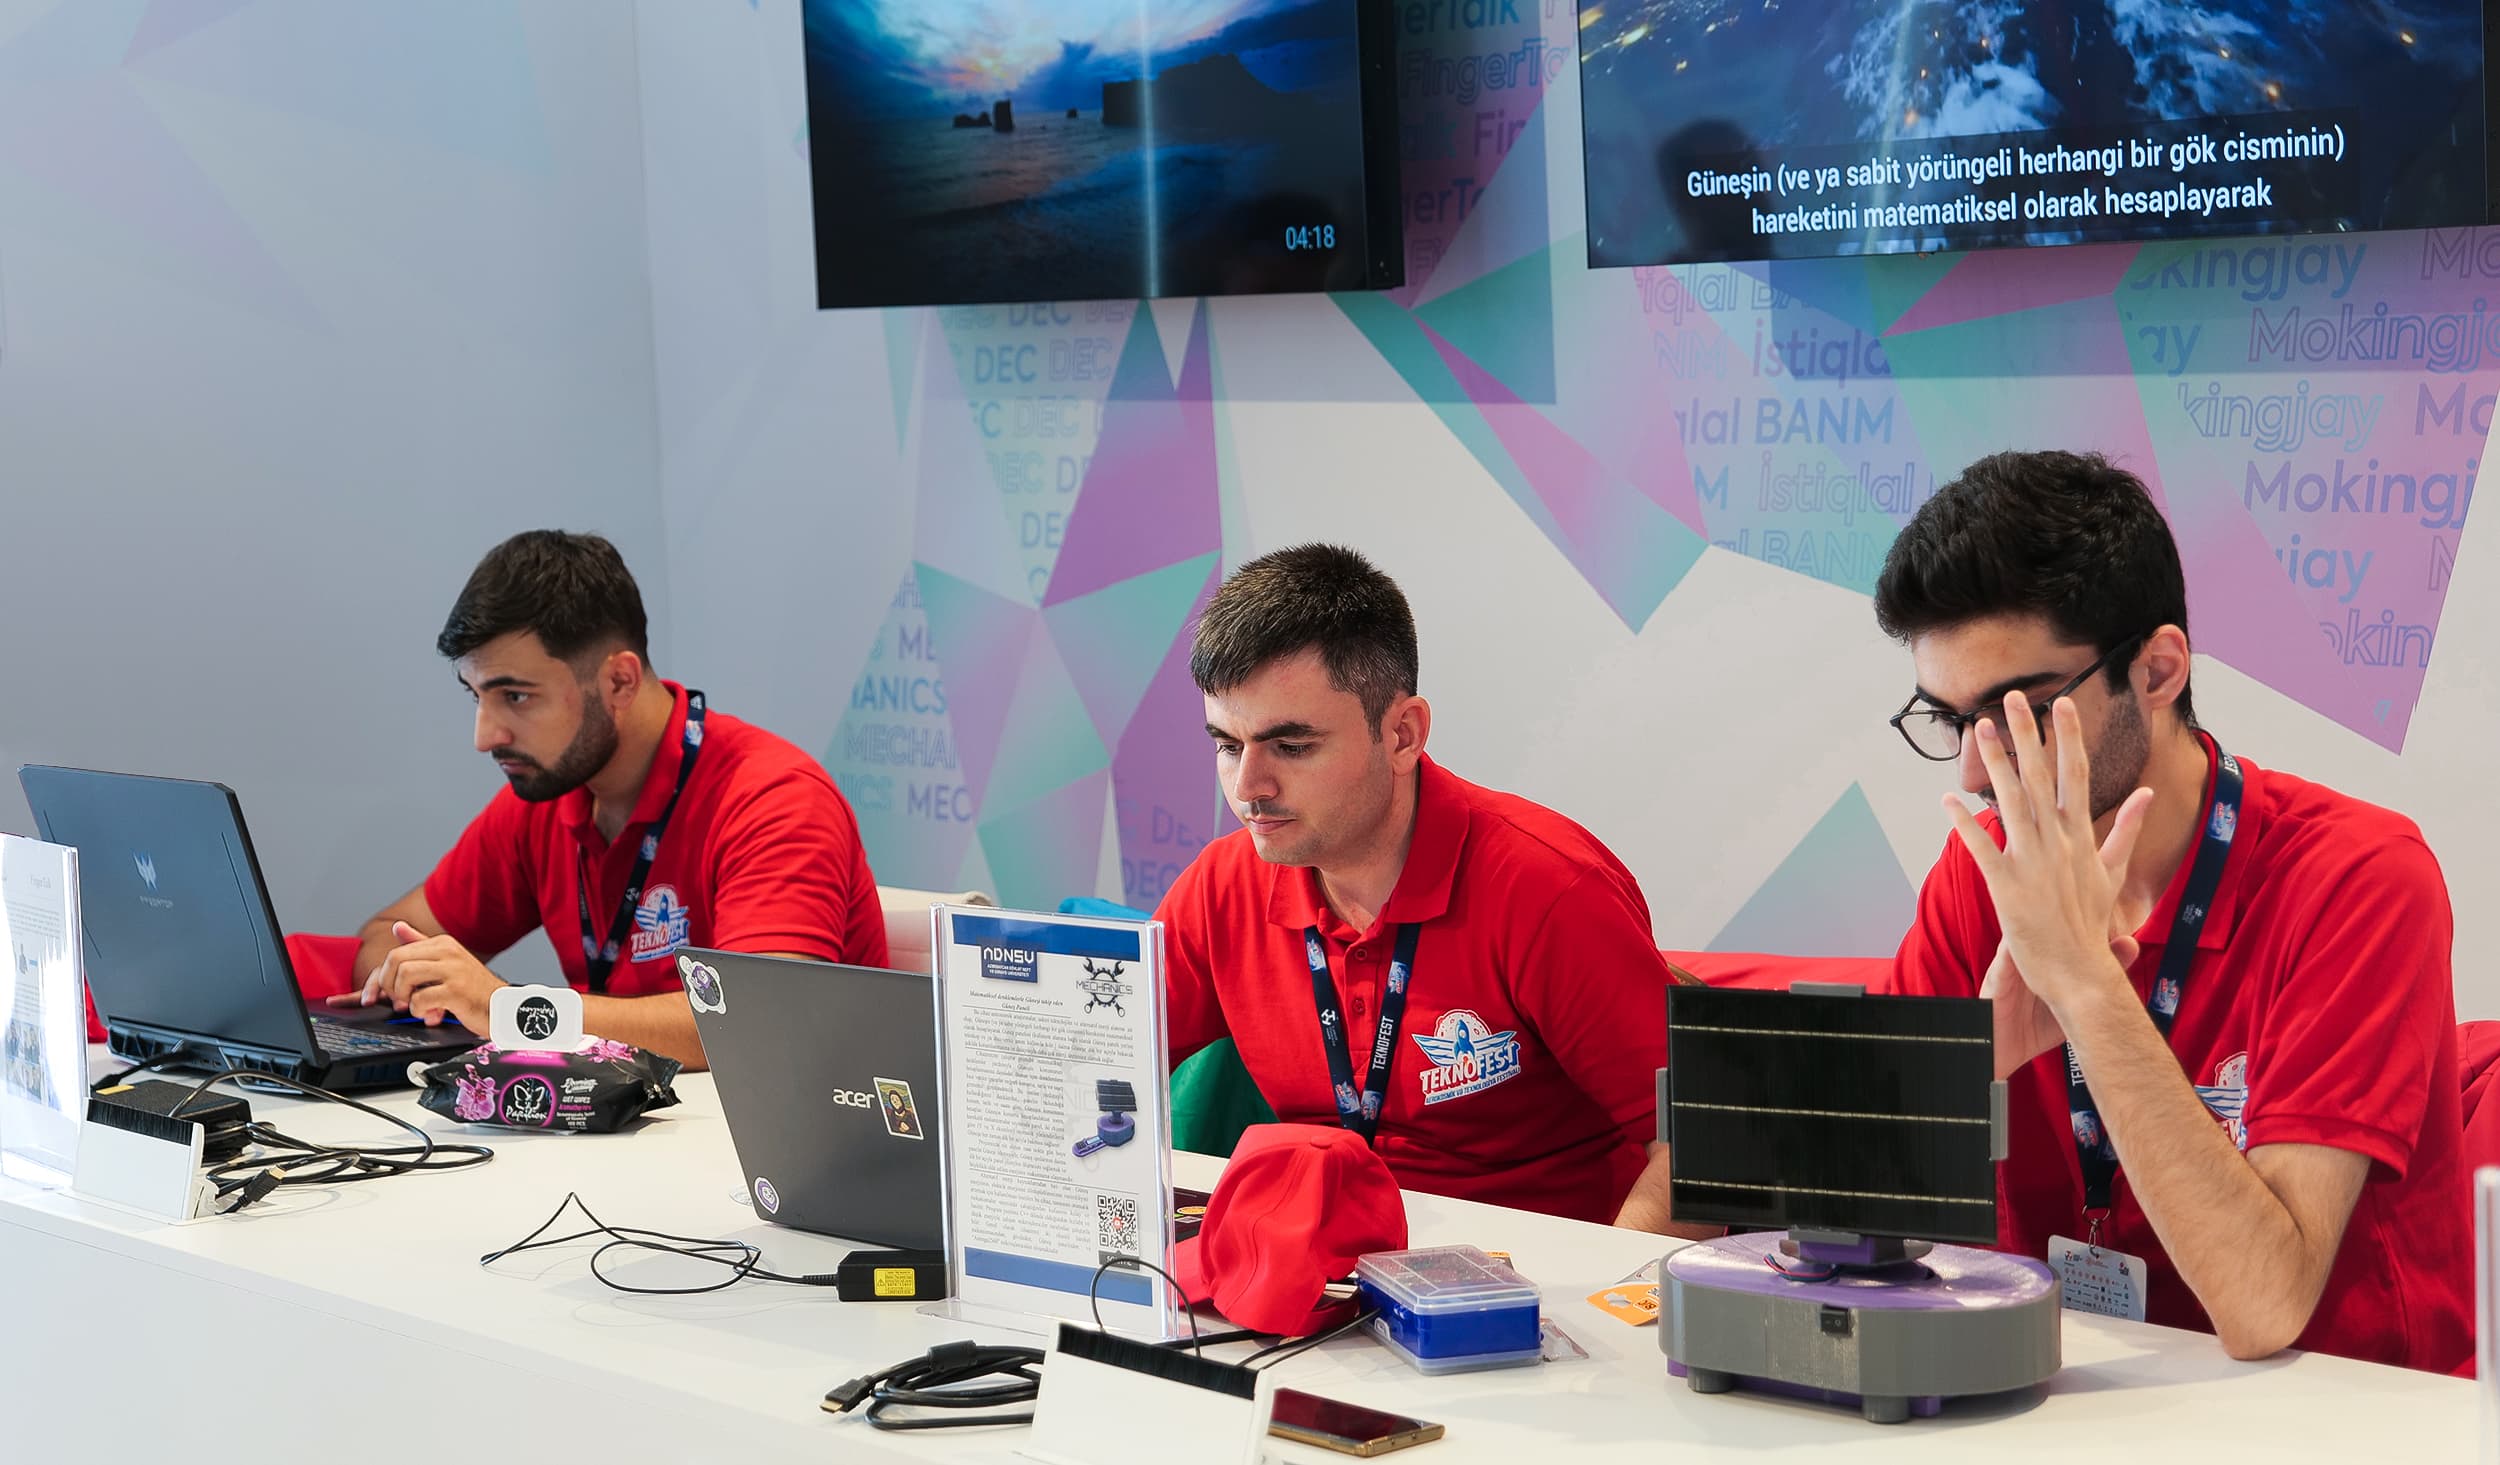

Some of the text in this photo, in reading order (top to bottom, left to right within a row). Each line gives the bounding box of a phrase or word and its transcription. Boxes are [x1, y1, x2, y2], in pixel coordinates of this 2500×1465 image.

[1687, 124, 2345, 200] Güneşin (ve ya sabit yörüngeli herhangi bir gök cisminin)
[1752, 177, 2273, 235] hareketini matematiksel olarak hesaplayarak
[1285, 224, 1336, 250] 04:18
[974, 344, 1038, 385] DEC
[1754, 397, 1895, 445] BANM
[1758, 449, 1915, 528] İstiqlal
[1075, 980, 1134, 996] MECHANICS
[1371, 1015, 1395, 1071] TEKNOFEST
[1420, 1041, 1521, 1094] TEKNOFEST
[832, 1088, 875, 1109] acer
